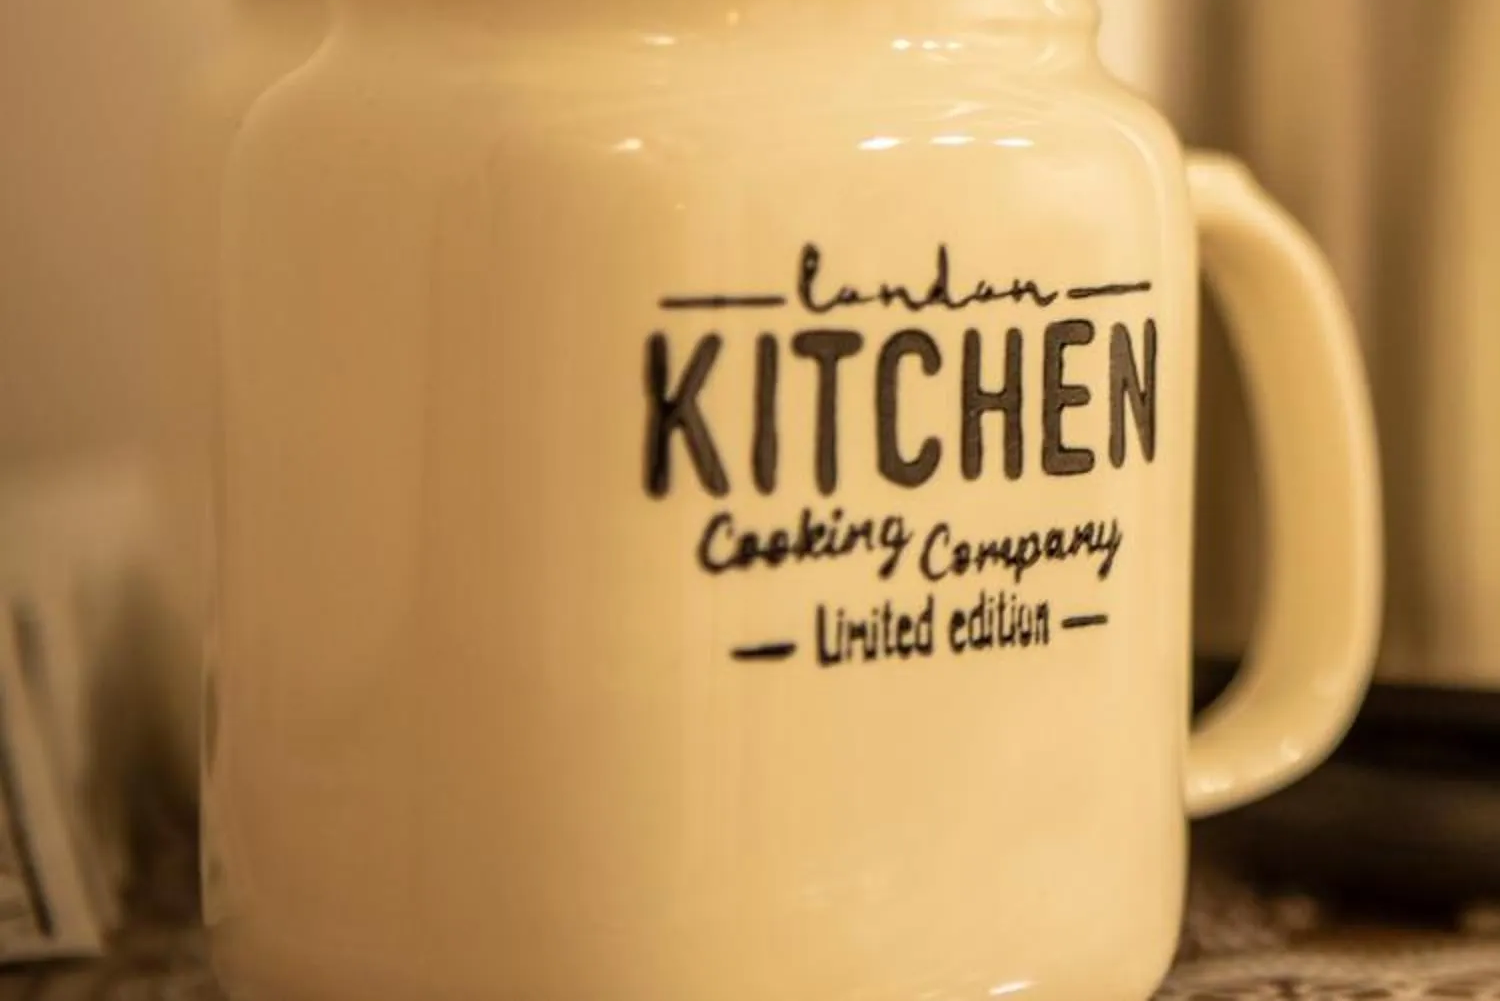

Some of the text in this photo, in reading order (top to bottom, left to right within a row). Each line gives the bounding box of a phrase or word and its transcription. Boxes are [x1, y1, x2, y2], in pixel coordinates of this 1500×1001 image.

[643, 317, 1158, 500] KITCHEN
[697, 507, 1122, 581] Cooking Company
[816, 590, 1050, 667] Limited edition
